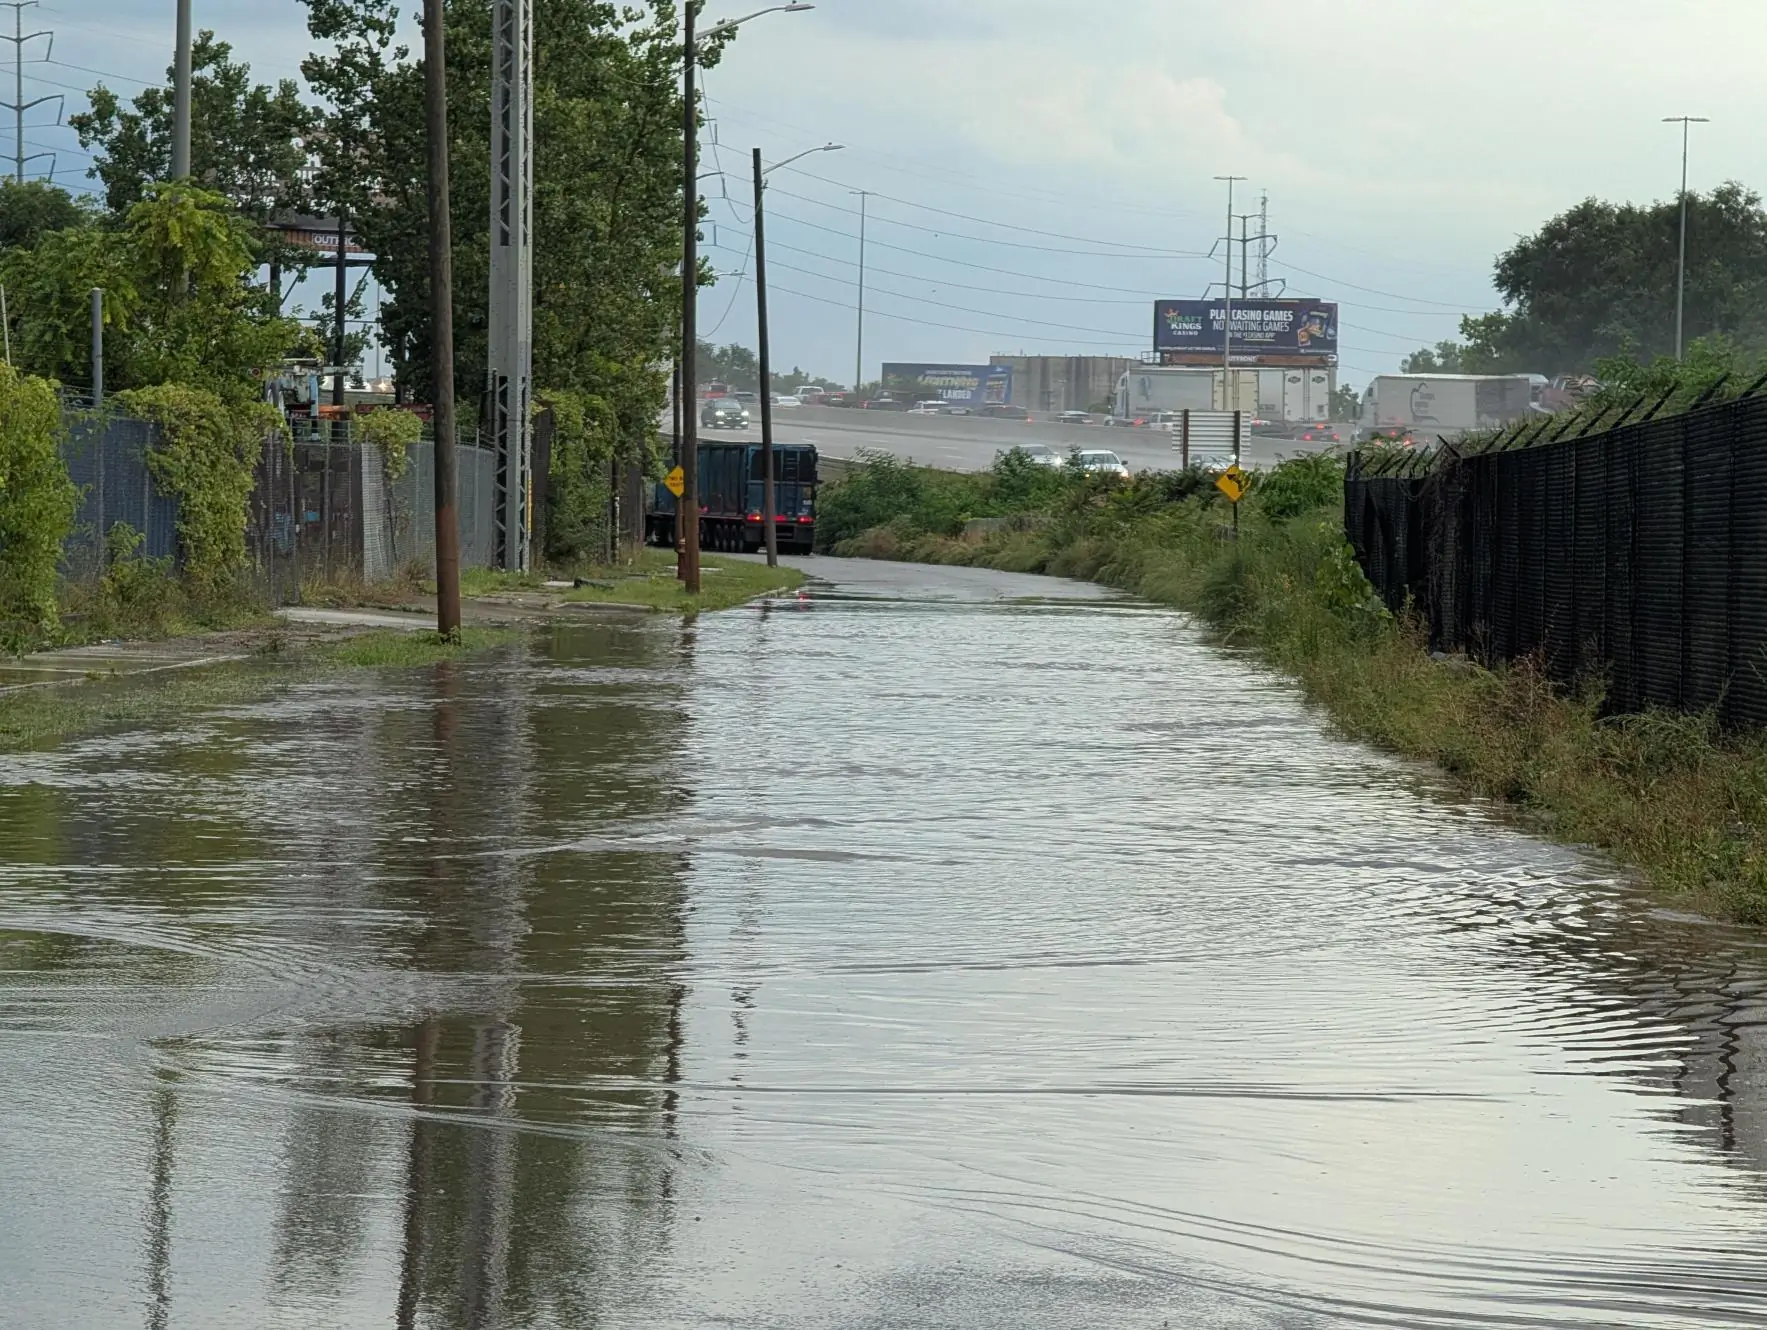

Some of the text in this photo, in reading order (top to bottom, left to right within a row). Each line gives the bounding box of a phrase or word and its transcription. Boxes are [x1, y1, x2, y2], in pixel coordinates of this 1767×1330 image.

[1209, 308, 1294, 322] PLA CASINO GAMES
[1171, 322, 1202, 330] KINGS
[1212, 320, 1290, 332] NO WAITING GAMES
